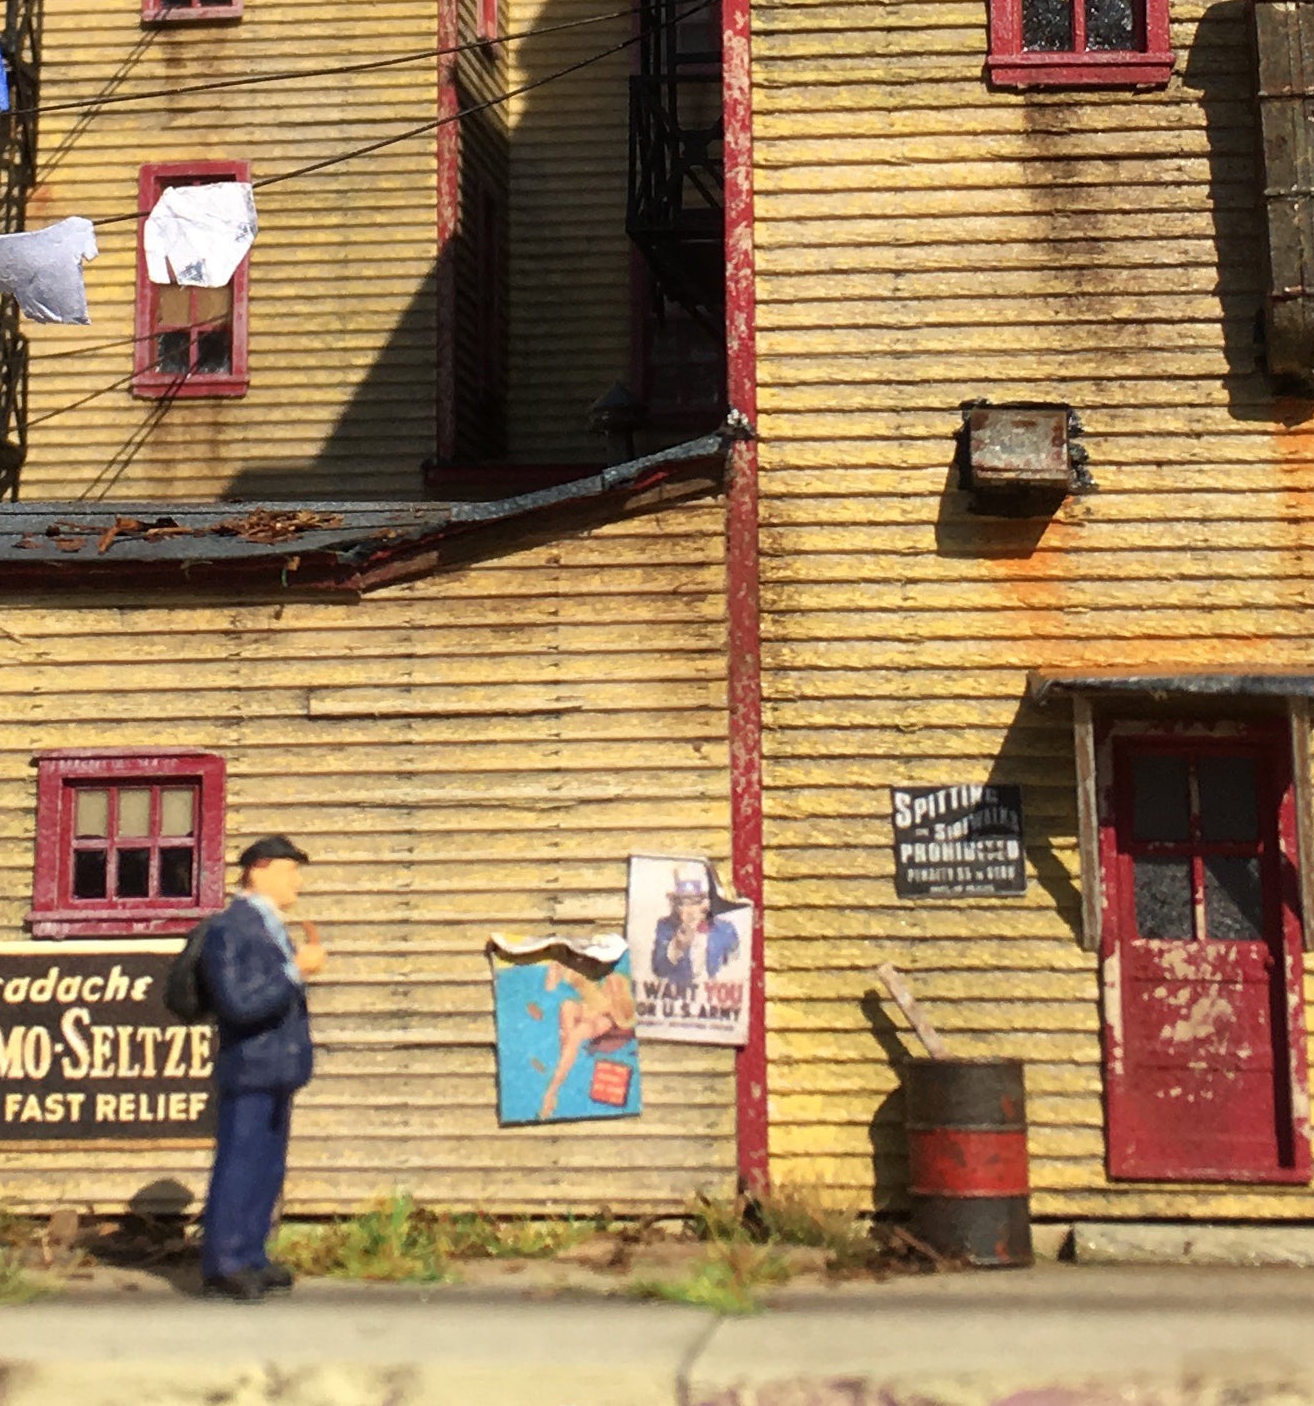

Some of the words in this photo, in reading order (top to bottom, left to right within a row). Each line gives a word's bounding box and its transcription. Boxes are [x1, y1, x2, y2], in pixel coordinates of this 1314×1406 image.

[643, 979, 699, 1001] WANT
[704, 980, 744, 1006] YOU
[635, 1002, 656, 1017] OR
[698, 1004, 742, 1022] ARMY
[3, 1093, 85, 1123] FAST
[94, 1092, 209, 1123] RELIEF
